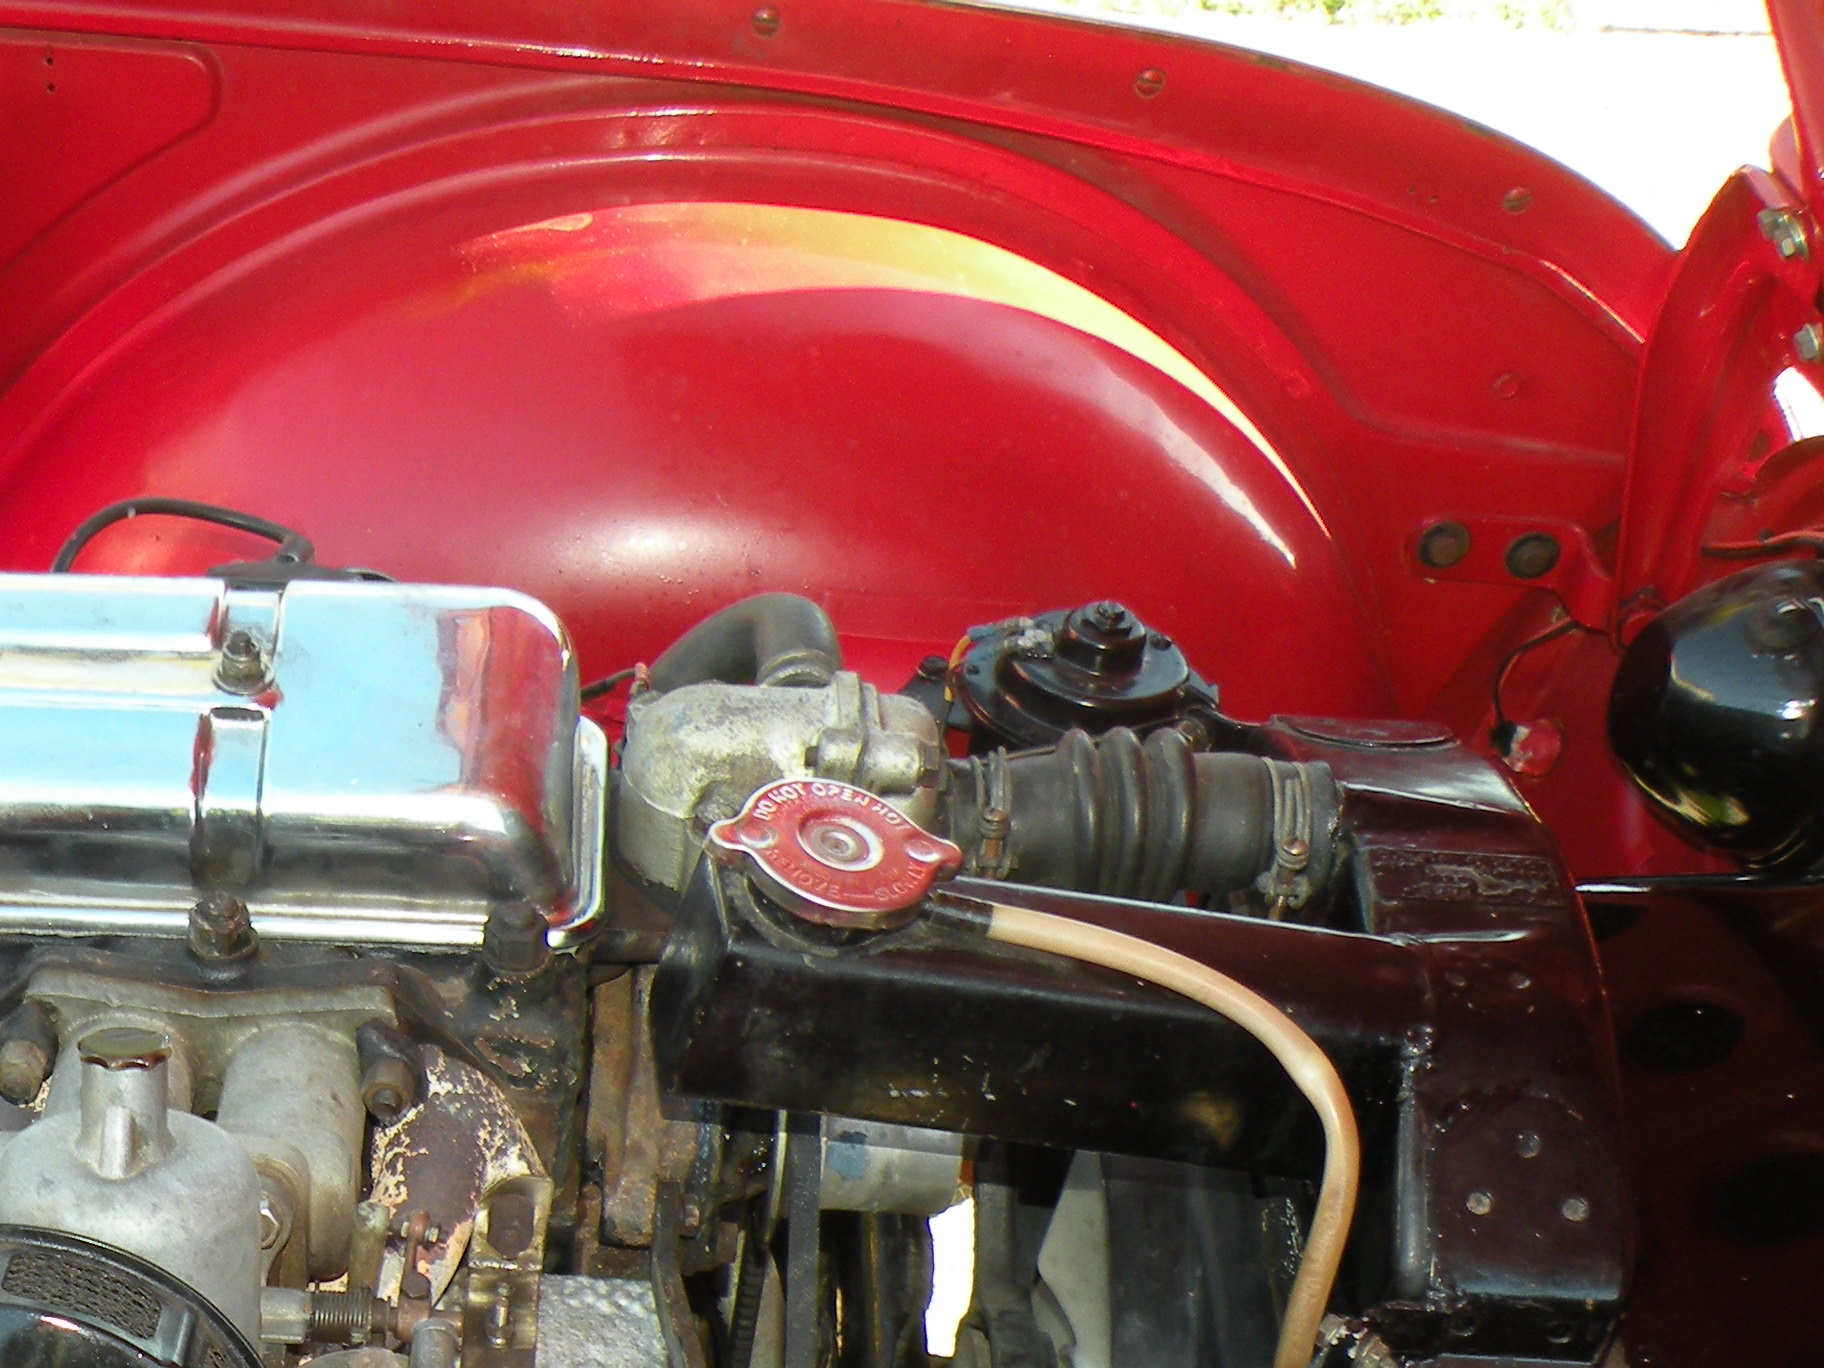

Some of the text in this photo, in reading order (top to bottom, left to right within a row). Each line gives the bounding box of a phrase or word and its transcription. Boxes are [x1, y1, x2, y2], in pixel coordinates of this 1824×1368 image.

[753, 782, 912, 831] DO NOT OPEN HOT
[764, 848, 926, 902] REMOVE SLOWLY
